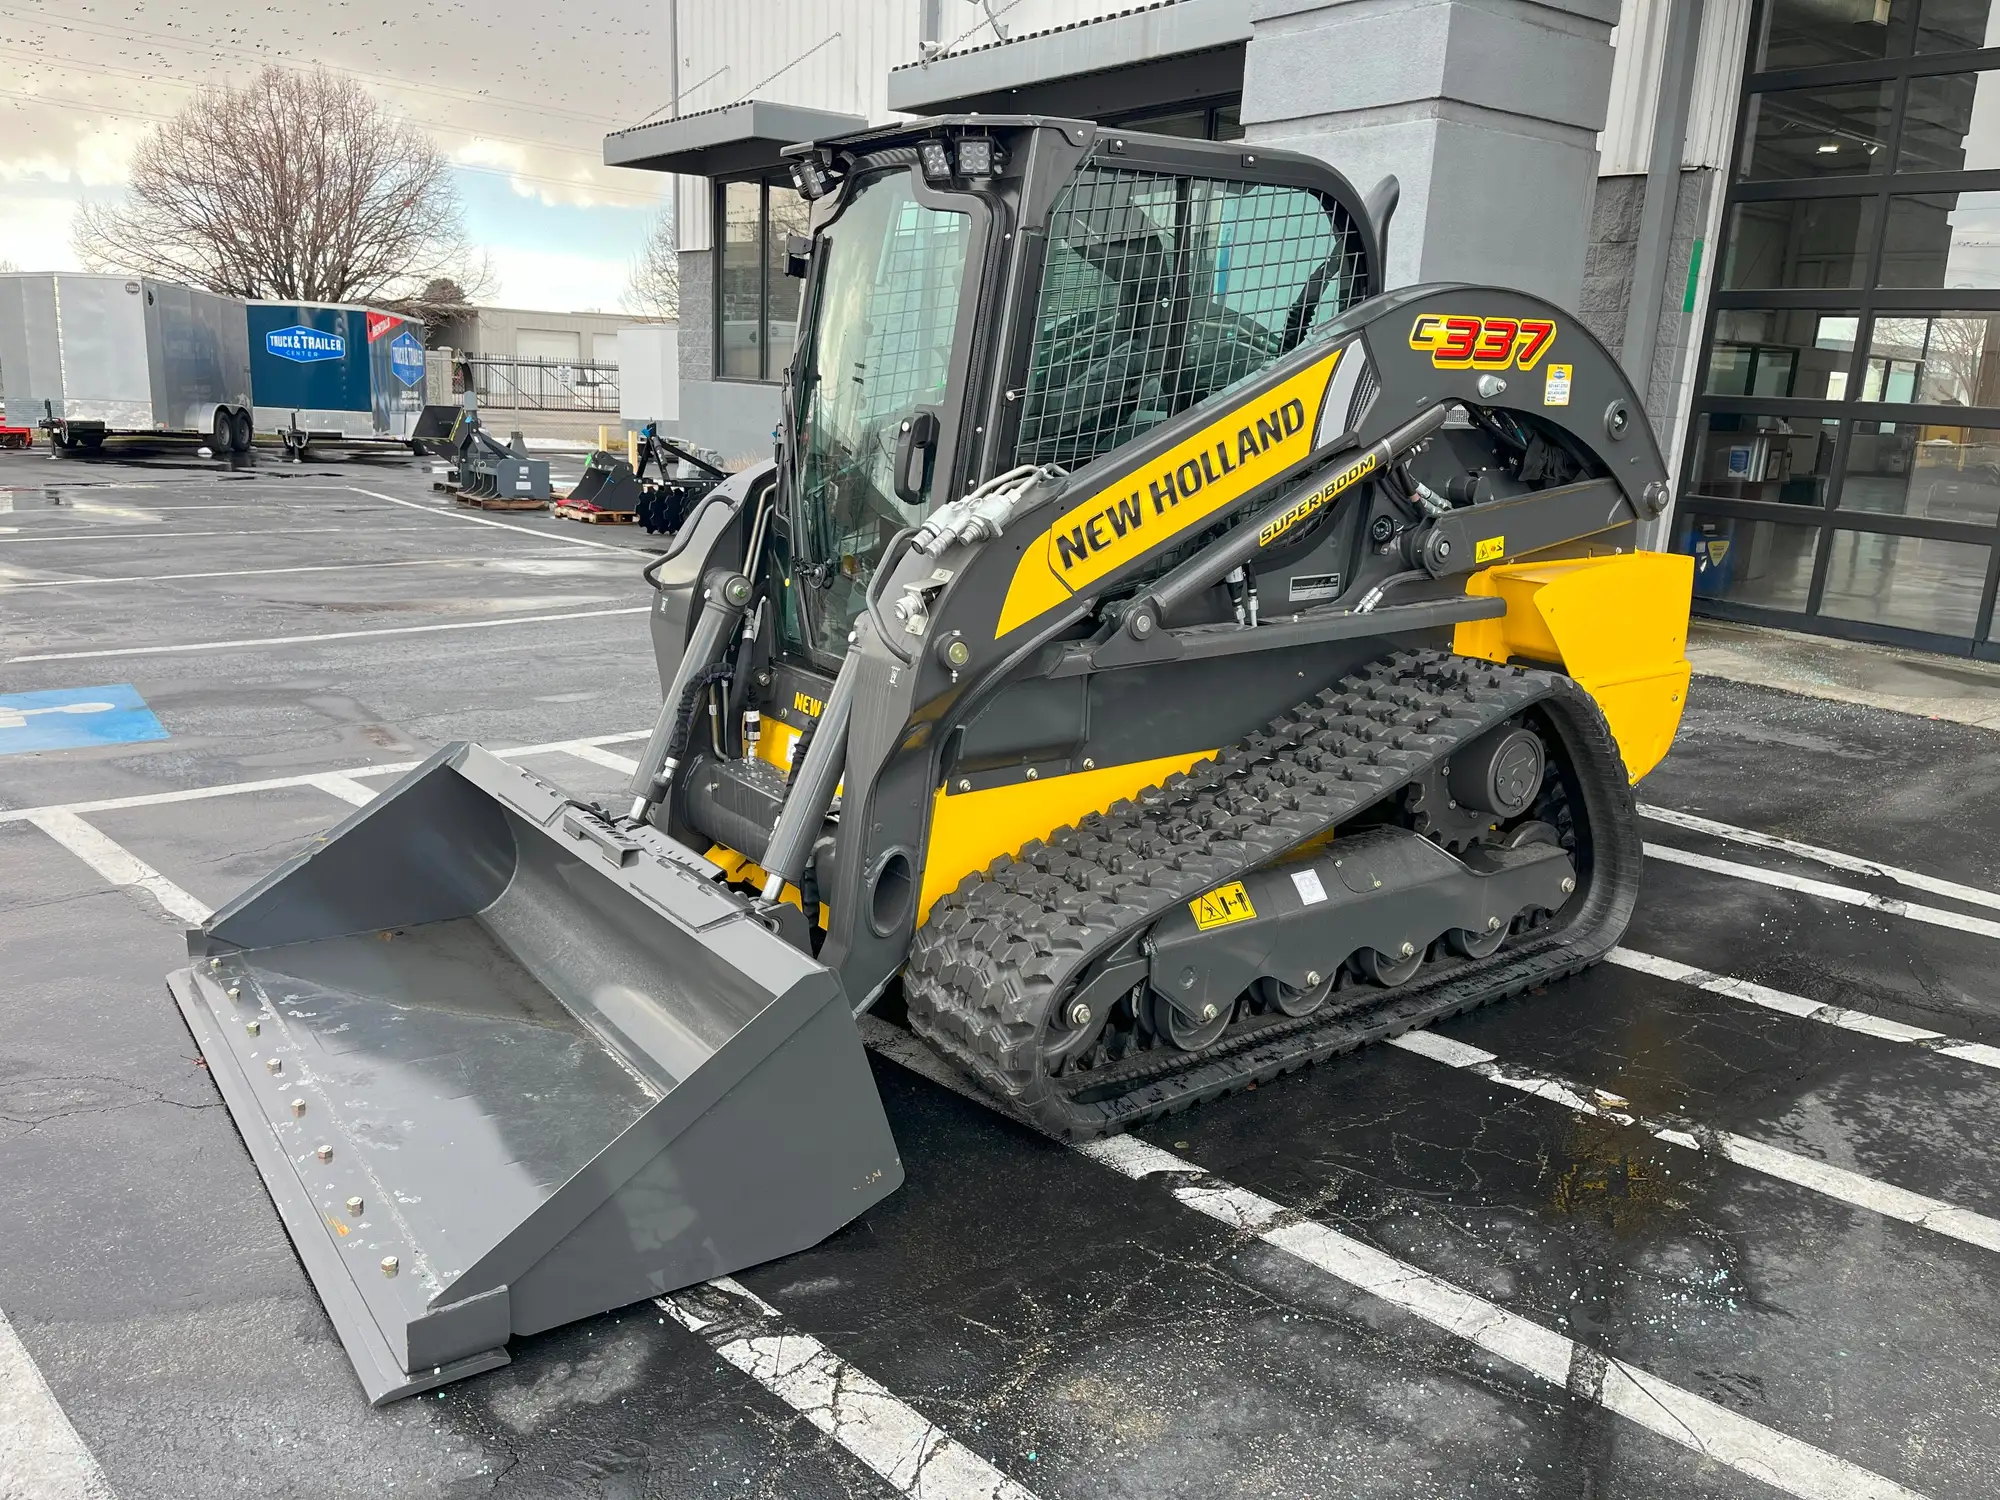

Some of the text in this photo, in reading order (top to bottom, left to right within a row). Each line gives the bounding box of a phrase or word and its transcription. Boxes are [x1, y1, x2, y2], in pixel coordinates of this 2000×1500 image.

[270, 335, 342, 351] TRUCK & TRAILER
[1409, 314, 1557, 371] C337
[1056, 397, 1305, 571] NEW HOLLAND
[1260, 454, 1375, 546] SUPER BOOM
[794, 691, 822, 718] NEW
